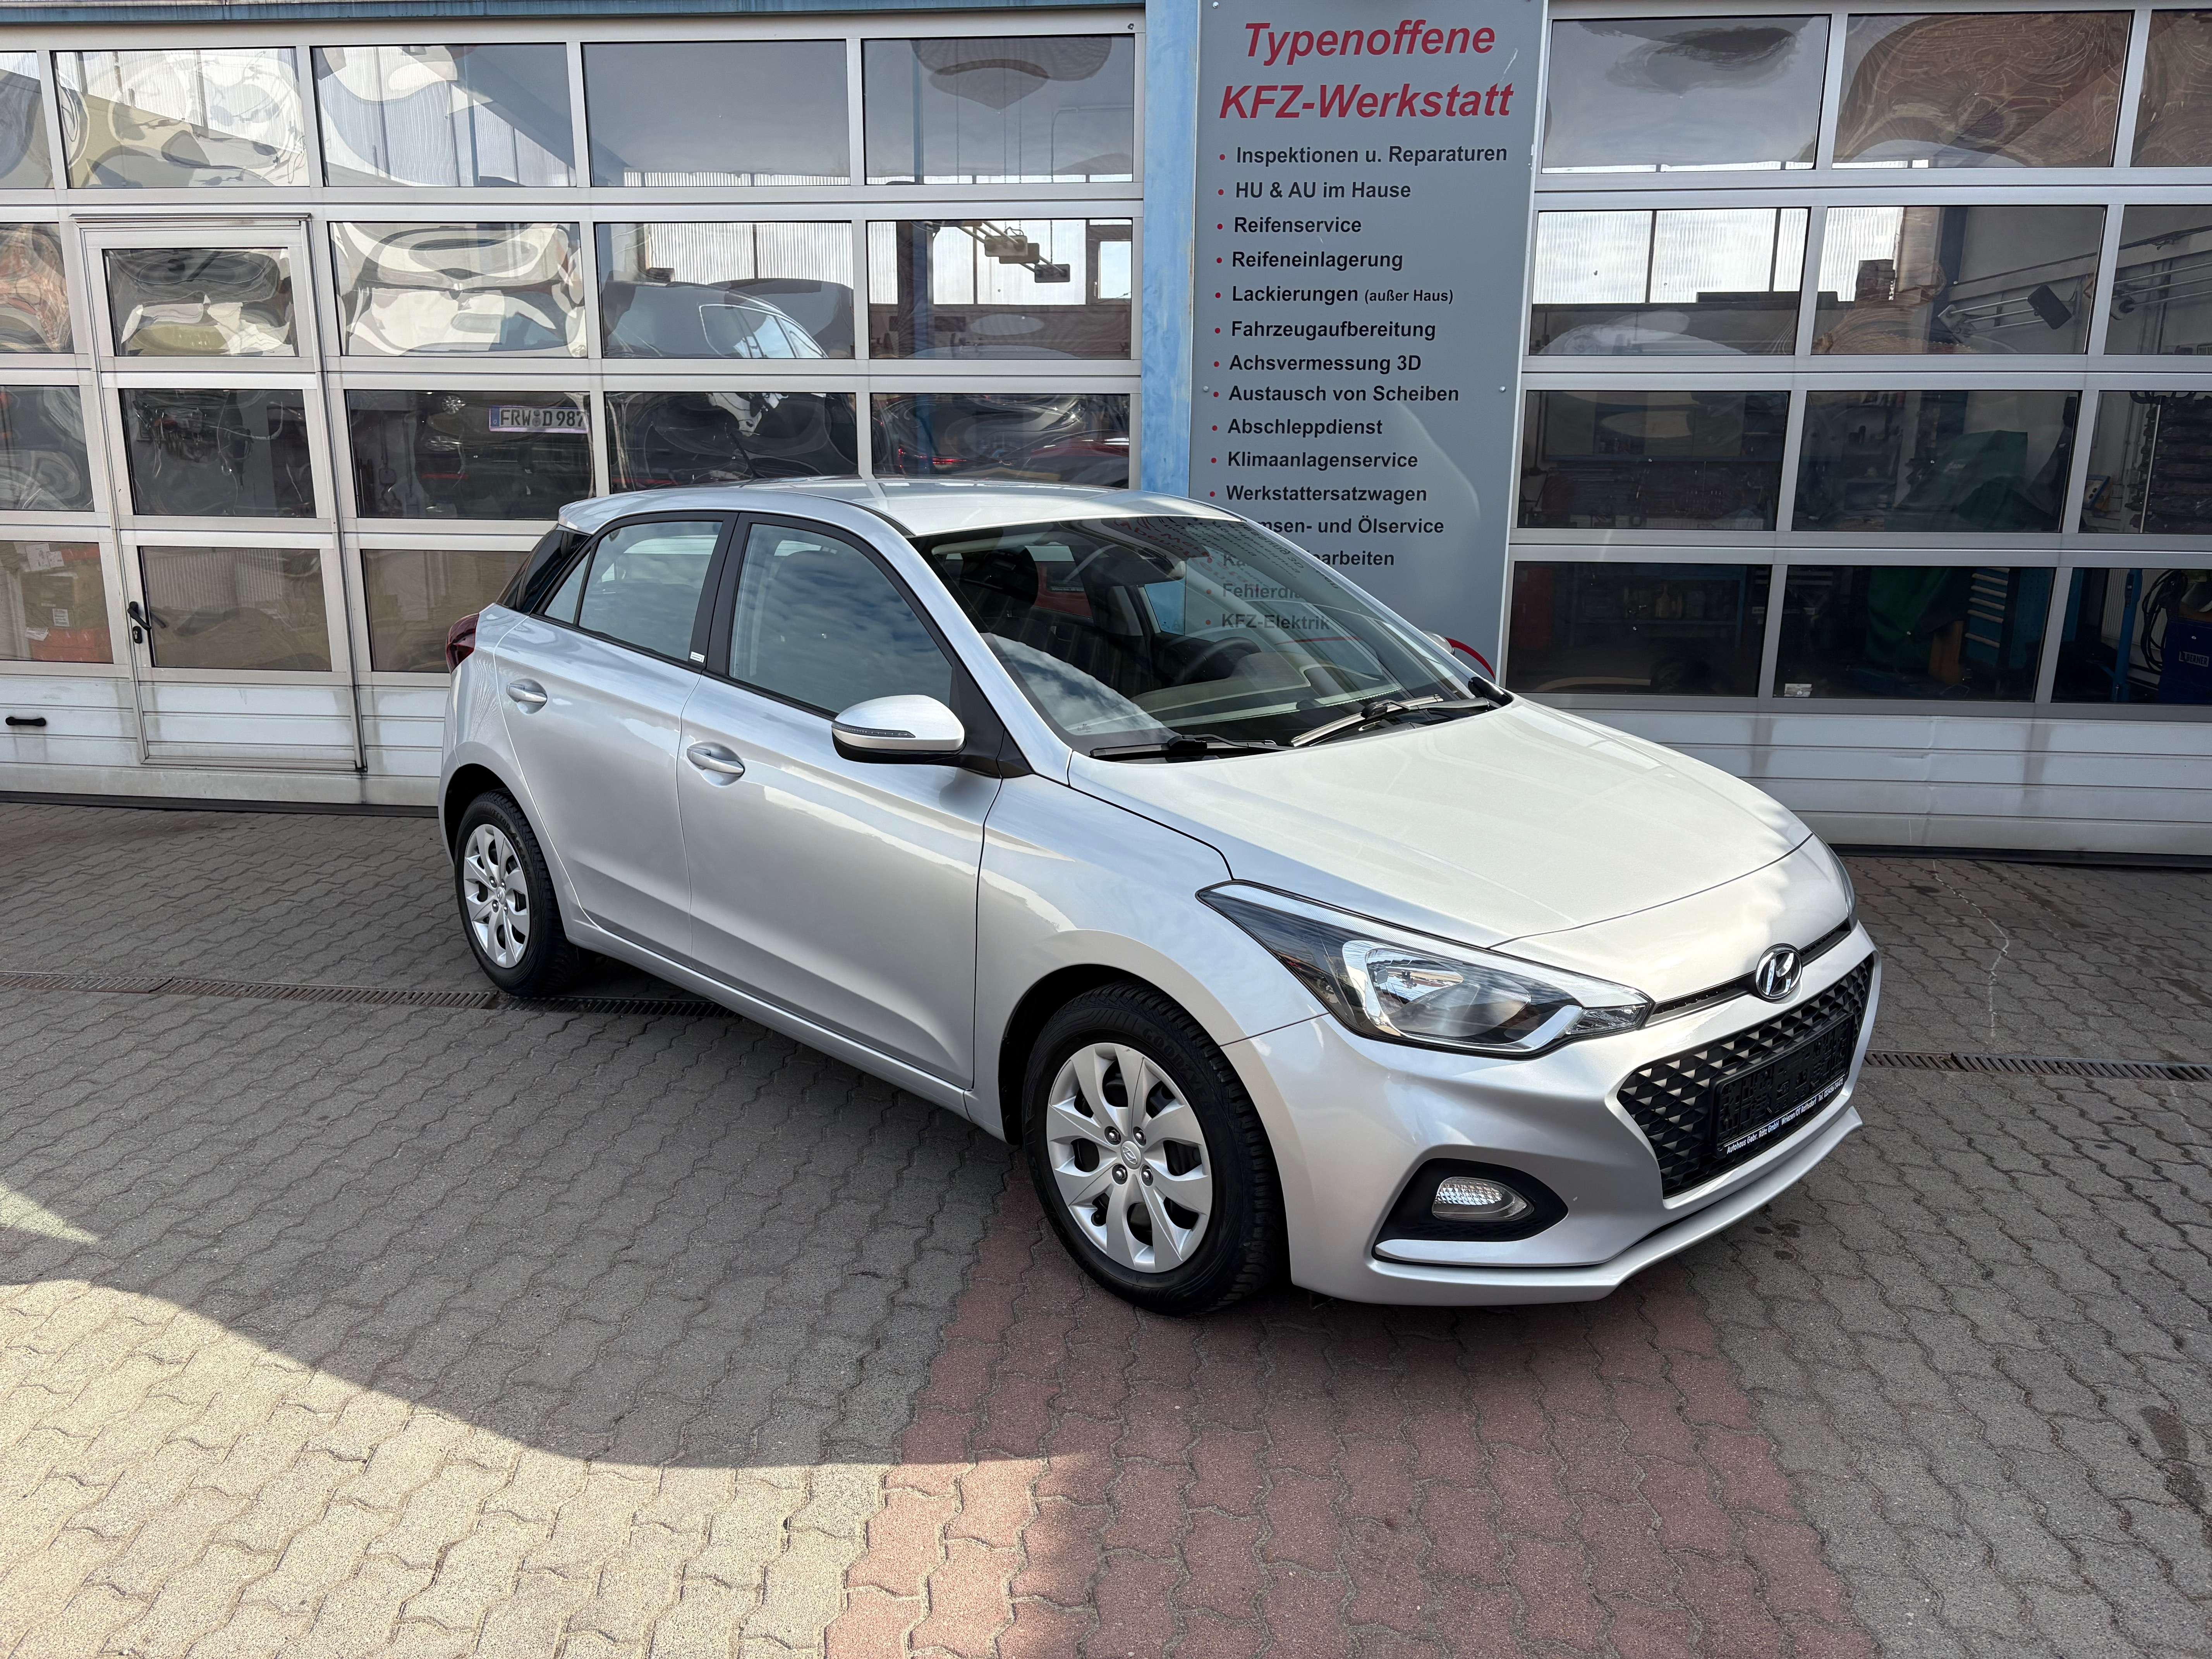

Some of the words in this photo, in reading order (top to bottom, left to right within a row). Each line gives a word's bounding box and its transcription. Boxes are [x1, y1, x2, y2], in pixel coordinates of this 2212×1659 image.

[1245, 19, 1495, 66] Typenoffene
[1219, 82, 1514, 118] KFZ-Werkstatt
[1237, 146, 1358, 167] Inspektionen
[1365, 150, 1382, 163] u.
[1389, 146, 1507, 167] Reparaturen
[1236, 182, 1263, 198] HU
[1269, 182, 1283, 198] &
[1288, 182, 1316, 198] AU
[1323, 181, 1345, 198] im
[1352, 181, 1411, 198] Hause
[1234, 216, 1362, 233] Reifenservice
[1232, 251, 1403, 271] Reifeneinlagerung
[1232, 285, 1358, 306] Lackierungen
[1364, 289, 1410, 305] (außer
[1413, 289, 1453, 305] Haus)
[1231, 320, 1436, 341] Fahrzeugaufbereitung
[1229, 354, 1391, 375] Achsvermessung
[1396, 355, 1421, 371] 3D
[1228, 385, 1326, 401] Austausch
[1332, 389, 1366, 401] von
[1372, 385, 1459, 401] Scheiben
[500, 409, 531, 426] FRW
[542, 410, 553, 426] D
[1227, 418, 1383, 438] Abschleppdienst
[1228, 451, 1418, 471] Klimaanlagenservice
[1226, 485, 1427, 505] Werkstattersatzwagen
[1318, 518, 1352, 533] und
[1358, 514, 1444, 534] Ölservice
[1222, 613, 1330, 630] KFZ-Elektrik
[2186, 653, 2208, 666] BERNER
[1142, 1027, 1220, 1127] GOODYEAR
[1727, 1138, 1747, 1154] Autohaus
[1747, 1133, 1758, 1144] Gebr.
[1768, 1120, 1779, 1133] GmbH
